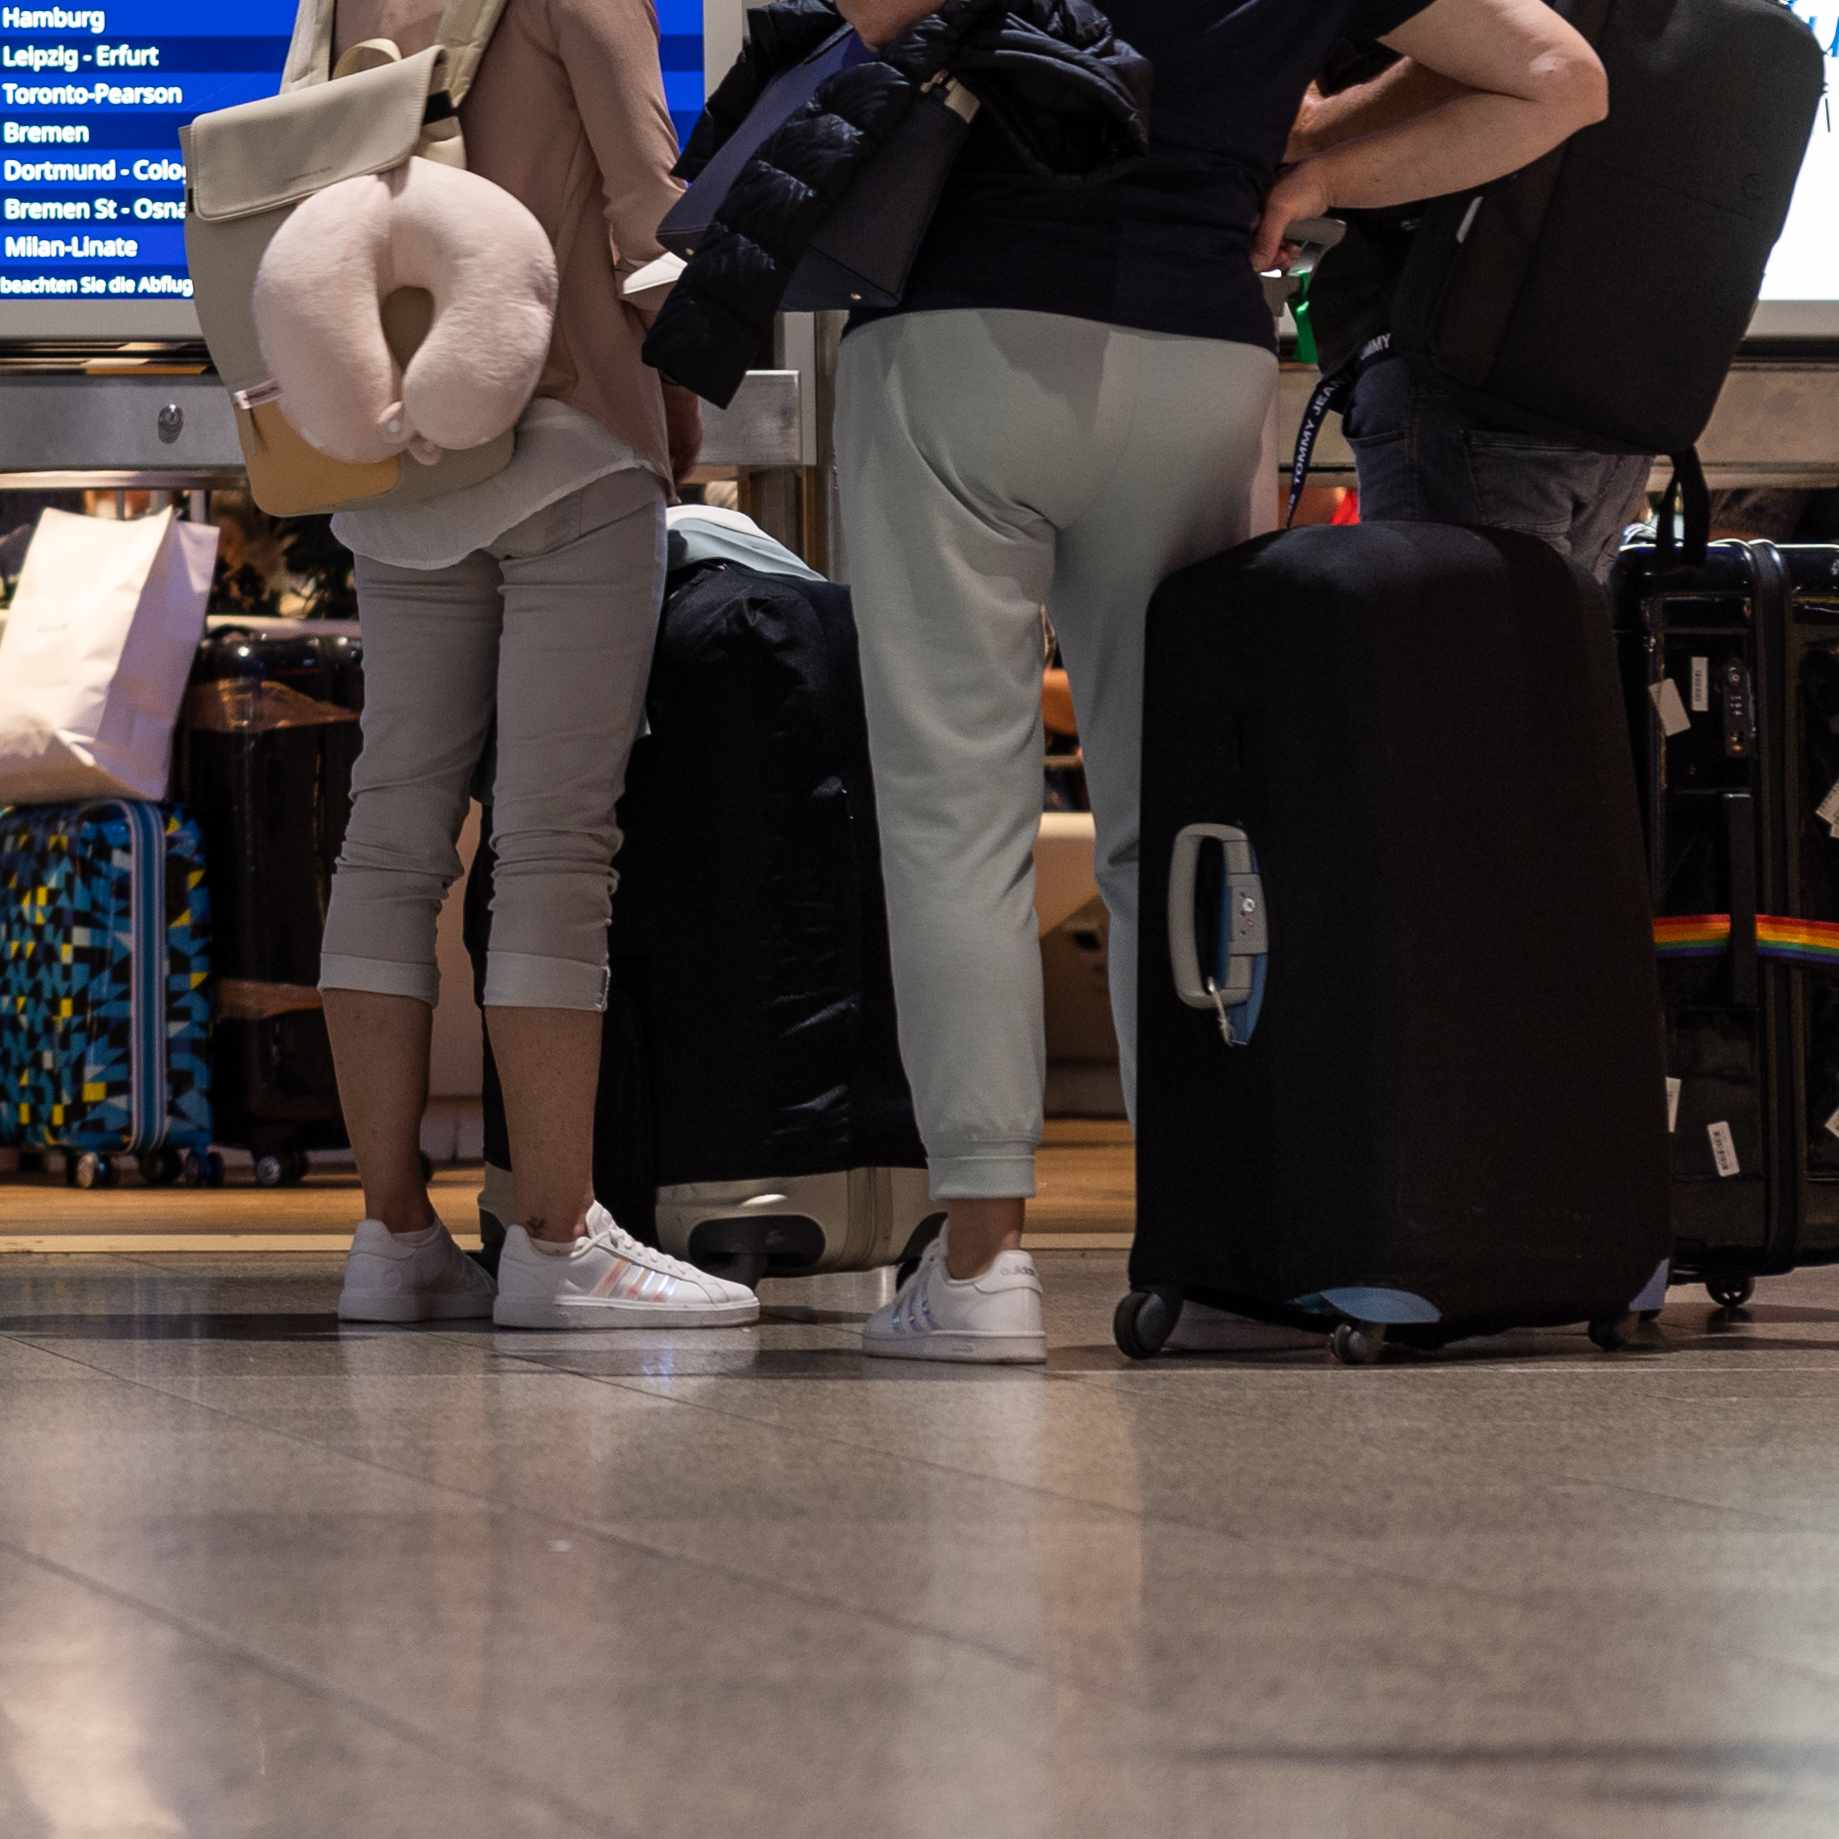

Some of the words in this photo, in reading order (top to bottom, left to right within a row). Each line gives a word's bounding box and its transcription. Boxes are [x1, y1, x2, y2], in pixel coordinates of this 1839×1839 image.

[2, 6, 105, 34] Hamburg
[1, 82, 183, 105] Toronto-Pearson
[4, 121, 90, 143] Bremen
[5, 235, 138, 258] Milan-Linate
[1293, 418, 1315, 485] TOMMY
